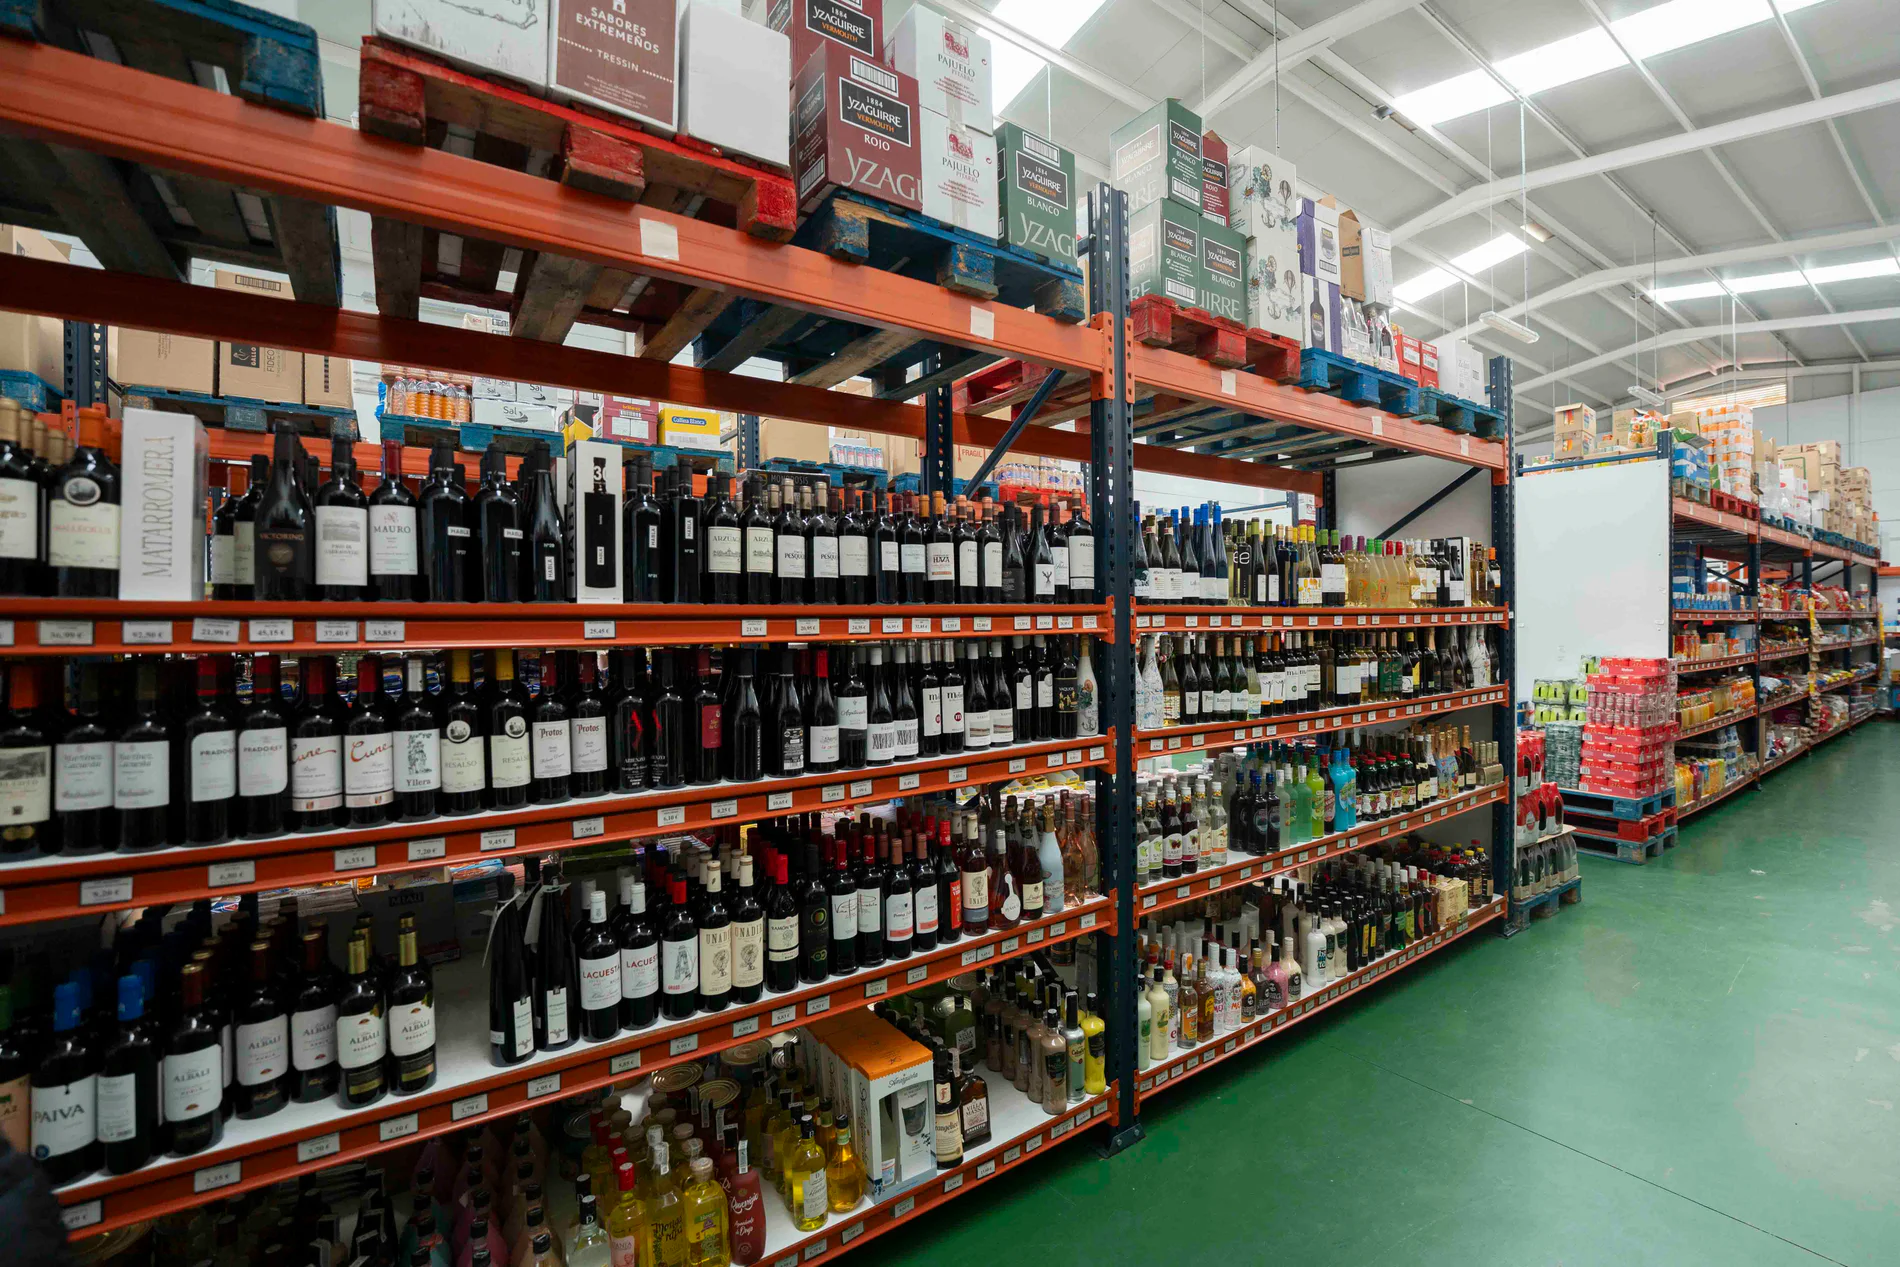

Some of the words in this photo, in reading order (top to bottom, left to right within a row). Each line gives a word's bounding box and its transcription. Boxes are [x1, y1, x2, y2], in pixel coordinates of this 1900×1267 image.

[591, 7, 647, 37] SABORES
[812, 5, 866, 39] YZAGUIRRE
[831, 6, 848, 20] 1884
[575, 13, 660, 54] EXTREMEÑOS
[821, 21, 859, 43] VERMOUTH
[596, 48, 639, 73] TRESSIN
[937, 53, 976, 77] PAJUELO
[866, 95, 883, 109] 1884
[847, 95, 903, 128] YZAGUIRRE
[856, 112, 895, 133] VERMOUTH
[864, 134, 890, 152] ROJO
[942, 156, 980, 179] PAJUELO
[1202, 166, 1224, 179] ZAGUIRRE
[1022, 165, 1062, 193] YZAGUIRRE
[1028, 180, 1057, 198] VERMOUTH
[1027, 196, 1060, 216] BLANCO
[1170, 249, 1192, 263] BLANCO
[1207, 250, 1237, 269] YZAGUIRRE
[1211, 274, 1236, 288] BLANCO
[529, 383, 543, 391] Sal
[503, 405, 517, 415] Sal
[141, 435, 176, 578] MATARROMERA
[373, 525, 412, 534] MAURO
[539, 727, 563, 739] Protos
[576, 723, 600, 734] Protos
[350, 740, 393, 763] Cune
[406, 778, 432, 787] Yllera
[349, 1030, 380, 1045] ALBALI
[174, 1068, 210, 1083] ALBALI
[32, 1103, 85, 1124] PAIVA
[965, 1106, 985, 1116] MASSA
[966, 1101, 983, 1112] VILLA
[935, 1119, 959, 1134] rangelico
